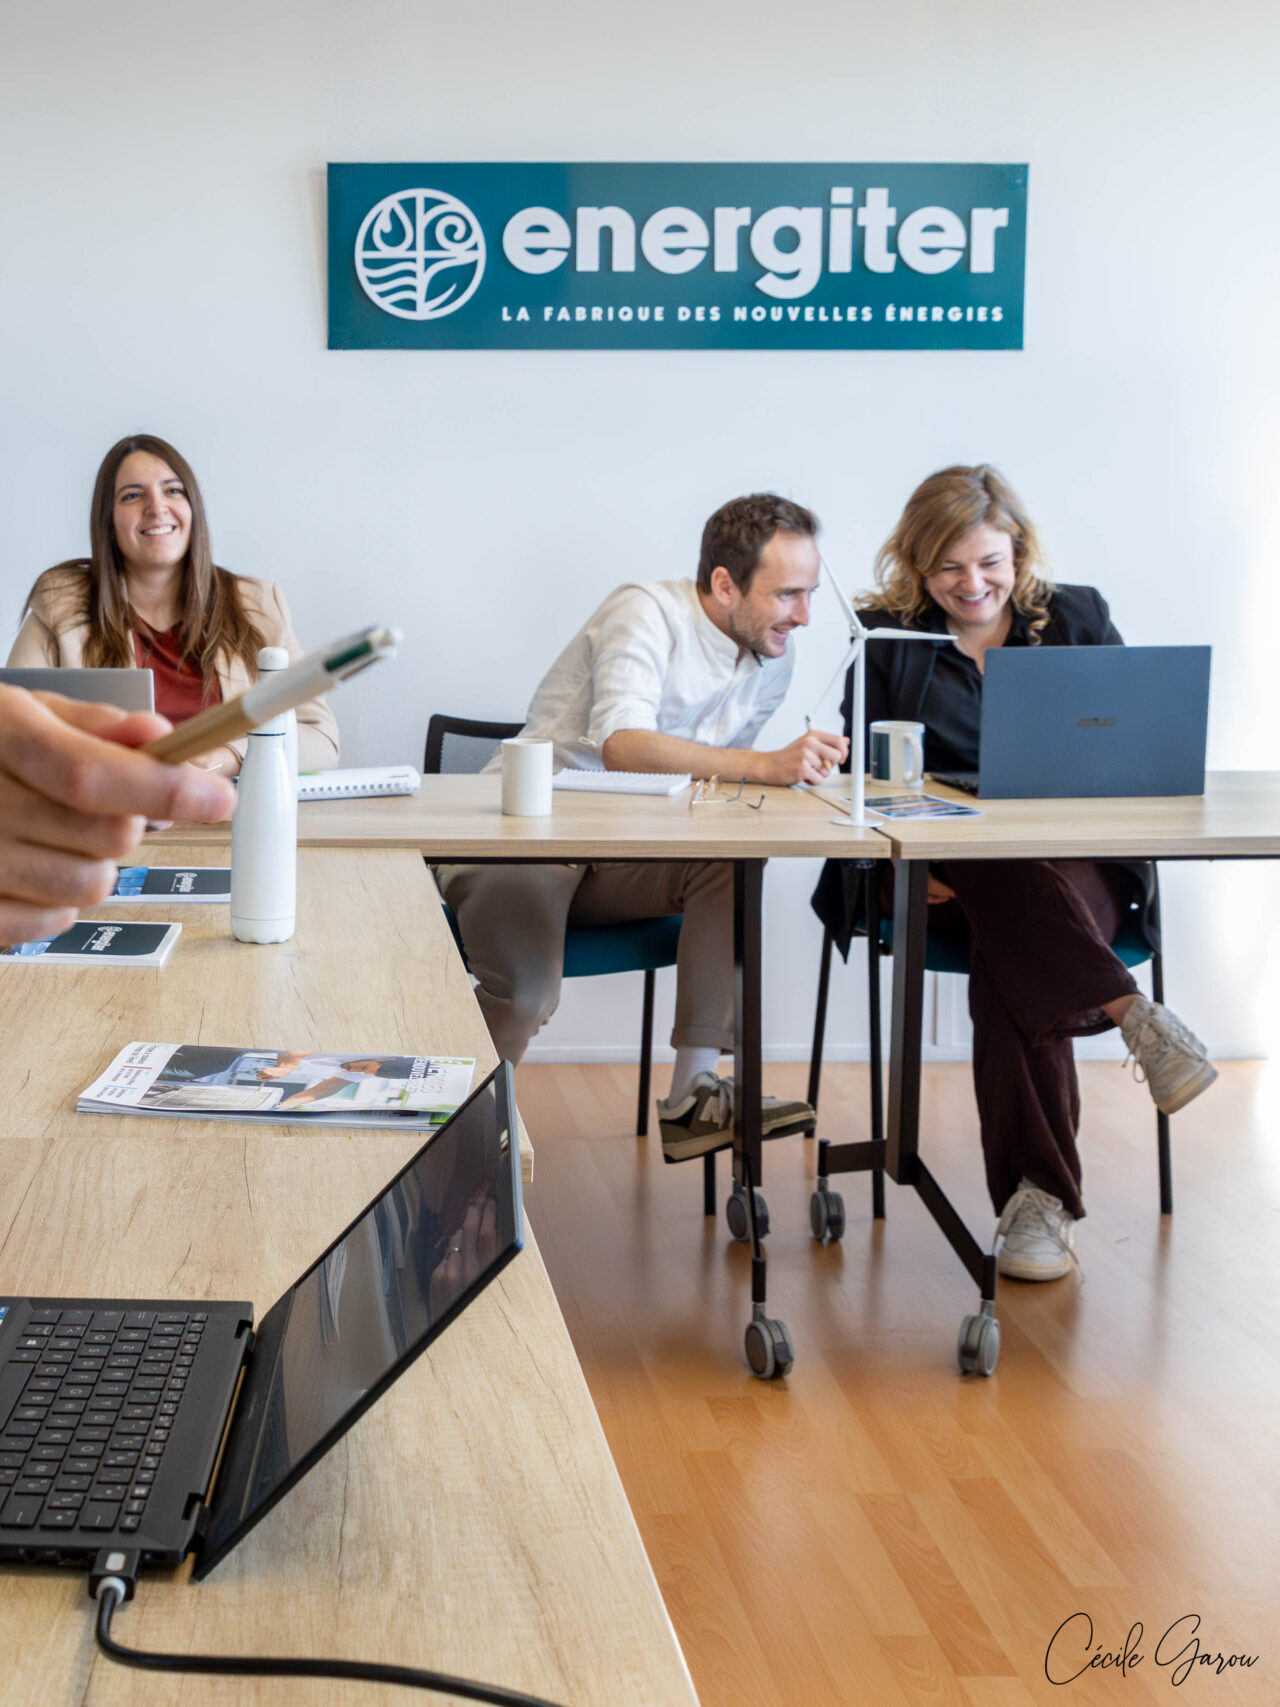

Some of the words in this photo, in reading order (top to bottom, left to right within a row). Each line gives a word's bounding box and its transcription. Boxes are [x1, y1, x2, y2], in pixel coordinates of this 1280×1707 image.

[503, 186, 1009, 299] energiter
[502, 307, 530, 321] LA
[544, 306, 665, 321] FABRIQUE
[678, 306, 721, 321] DES
[734, 306, 873, 322] NOUVELLES
[885, 303, 1003, 322] ÉNERGIES
